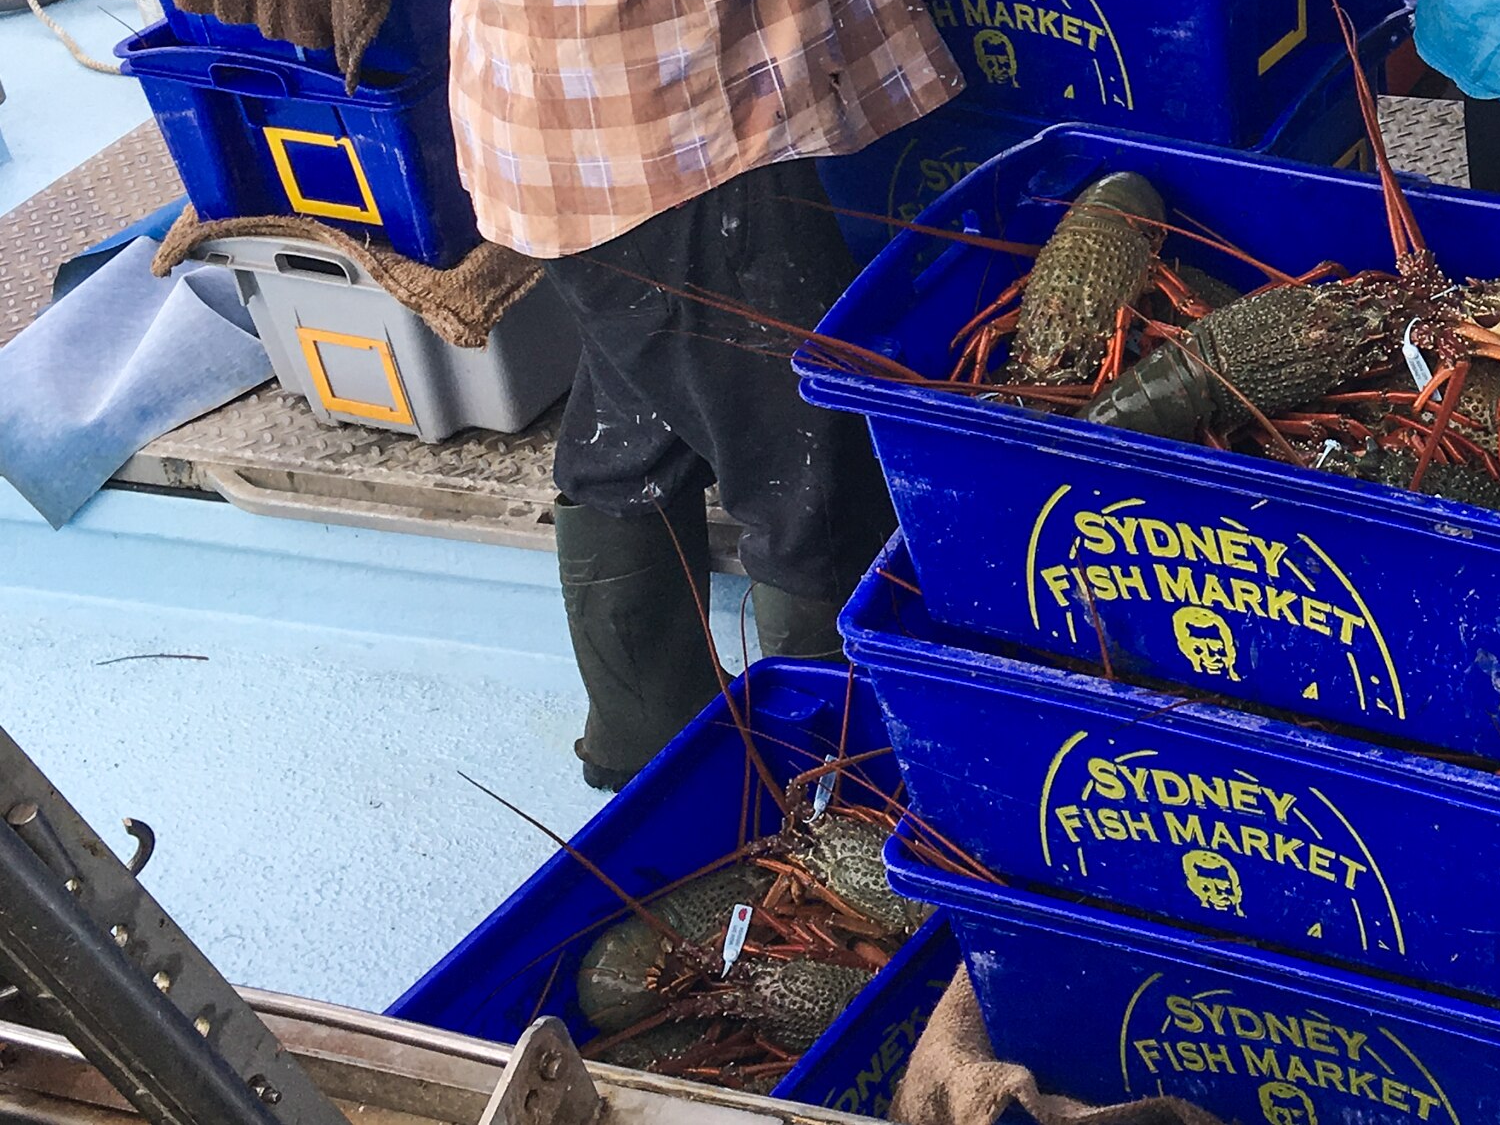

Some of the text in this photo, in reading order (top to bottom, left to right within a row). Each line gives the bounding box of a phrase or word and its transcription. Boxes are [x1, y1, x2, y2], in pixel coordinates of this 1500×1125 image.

[1074, 510, 1287, 578] SYDNEY
[1041, 565, 1364, 645] FISH MARKET
[1087, 757, 1297, 824] SYDNEY
[1055, 805, 1367, 891] FISH MARKET
[1166, 995, 1368, 1061] SYDNEY
[1134, 1039, 1441, 1121] FISH MARKET
